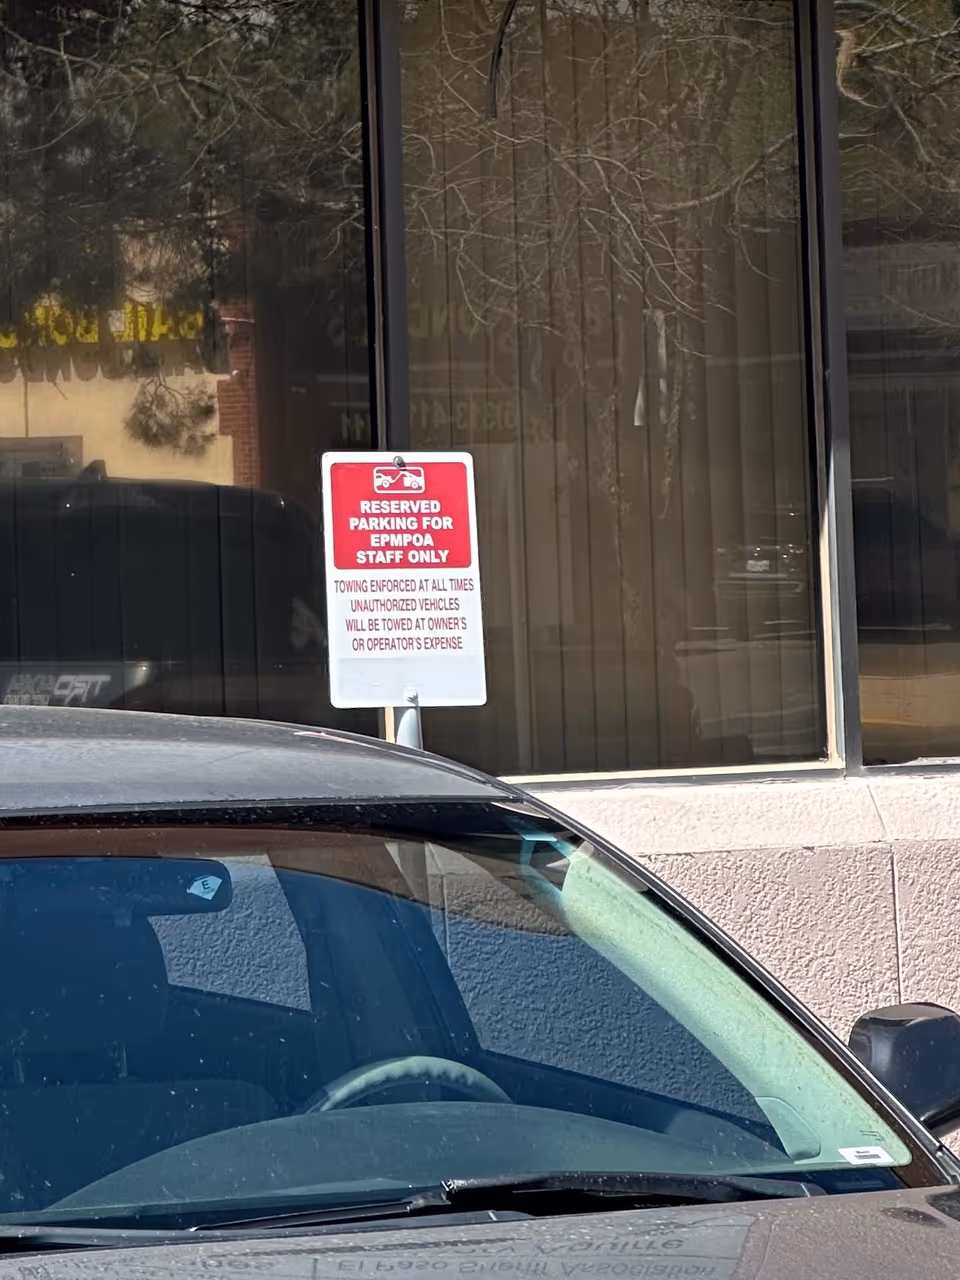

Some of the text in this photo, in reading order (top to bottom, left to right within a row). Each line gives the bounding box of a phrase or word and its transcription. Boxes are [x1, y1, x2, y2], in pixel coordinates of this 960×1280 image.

[360, 500, 441, 514] RESERVED
[349, 517, 453, 530] PARKING FOR
[370, 533, 434, 547] EPMPOA
[356, 550, 449, 564] STAFF ONLY
[334, 578, 474, 593] TOWING ENFORCED AT ALL TIMES
[351, 598, 459, 613] UNAUTHORIZED VEHICLES
[345, 617, 467, 632] WILL BE TOWED AT OWNER'S
[352, 636, 462, 651] OR OPERATOR'S EXPENSE
